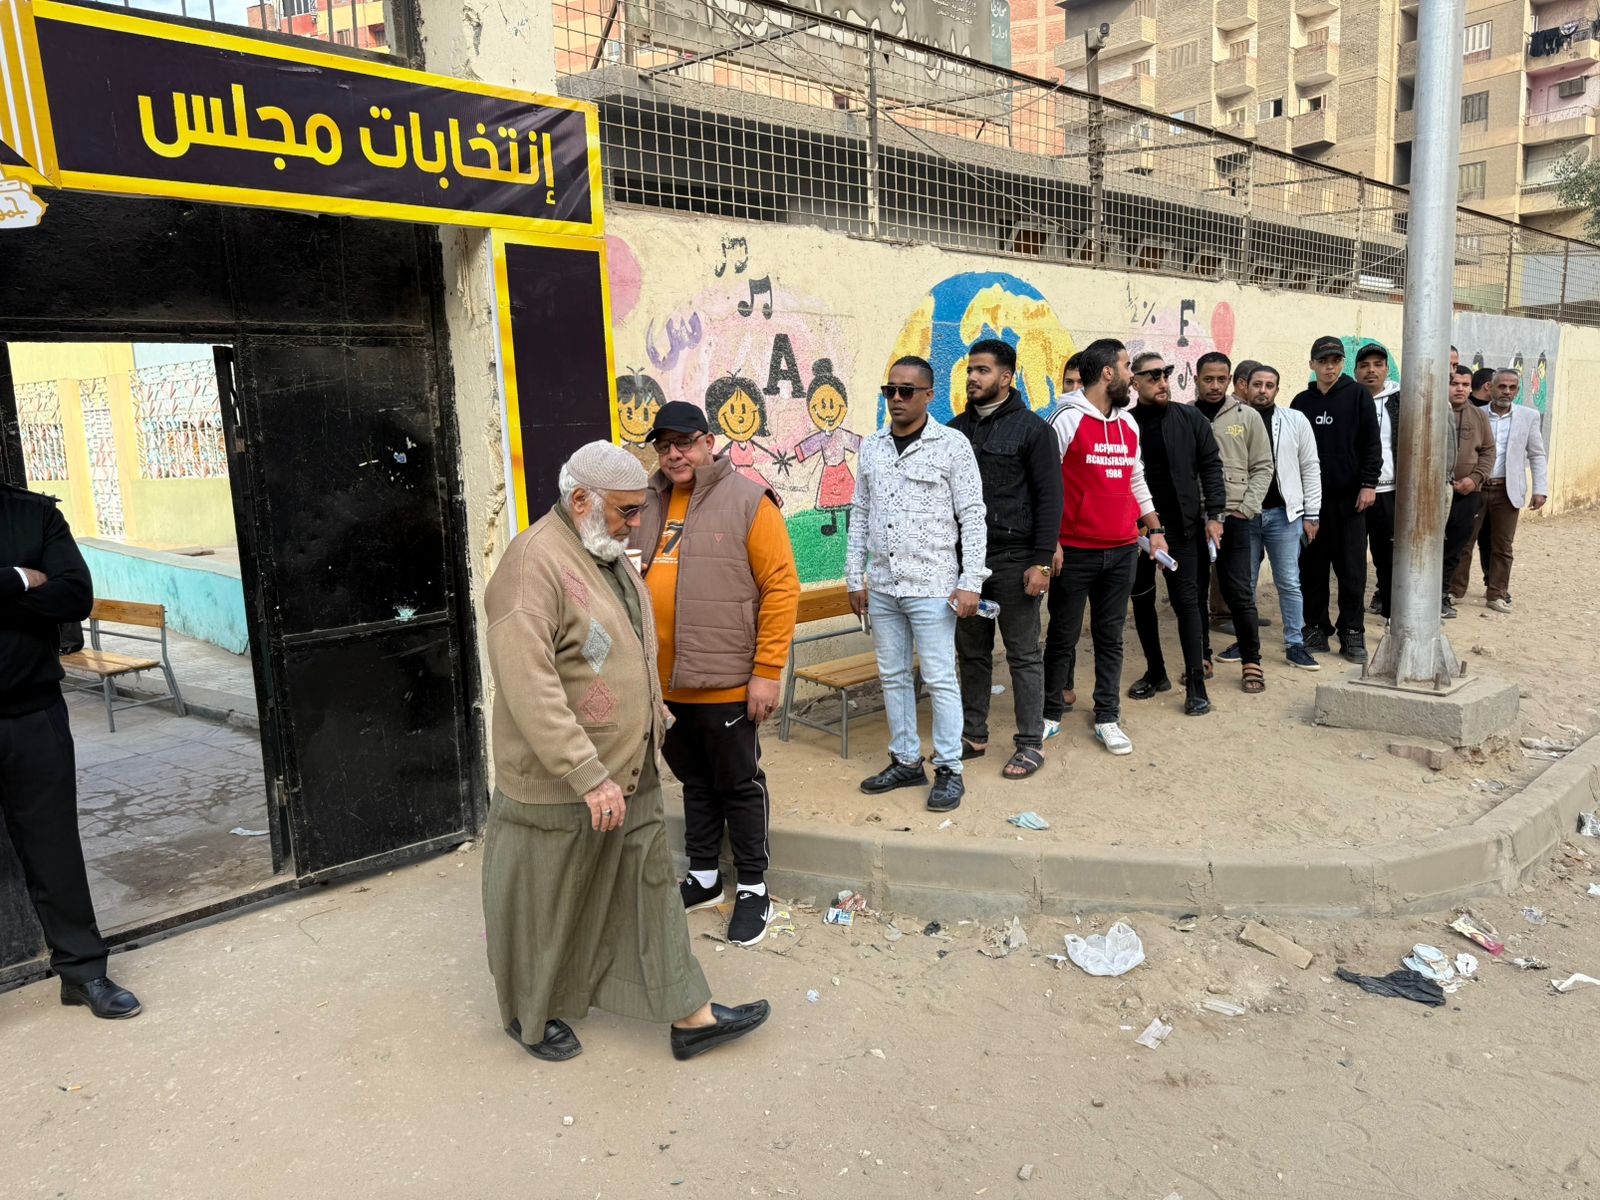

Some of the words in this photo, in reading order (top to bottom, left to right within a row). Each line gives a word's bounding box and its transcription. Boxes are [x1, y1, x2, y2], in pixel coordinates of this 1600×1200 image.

[138, 83, 343, 171] مجلس
[359, 105, 555, 205] إنتخابات
[763, 333, 807, 399] A
[1315, 410, 1333, 424] alo
[1105, 468, 1122, 478] 1988
